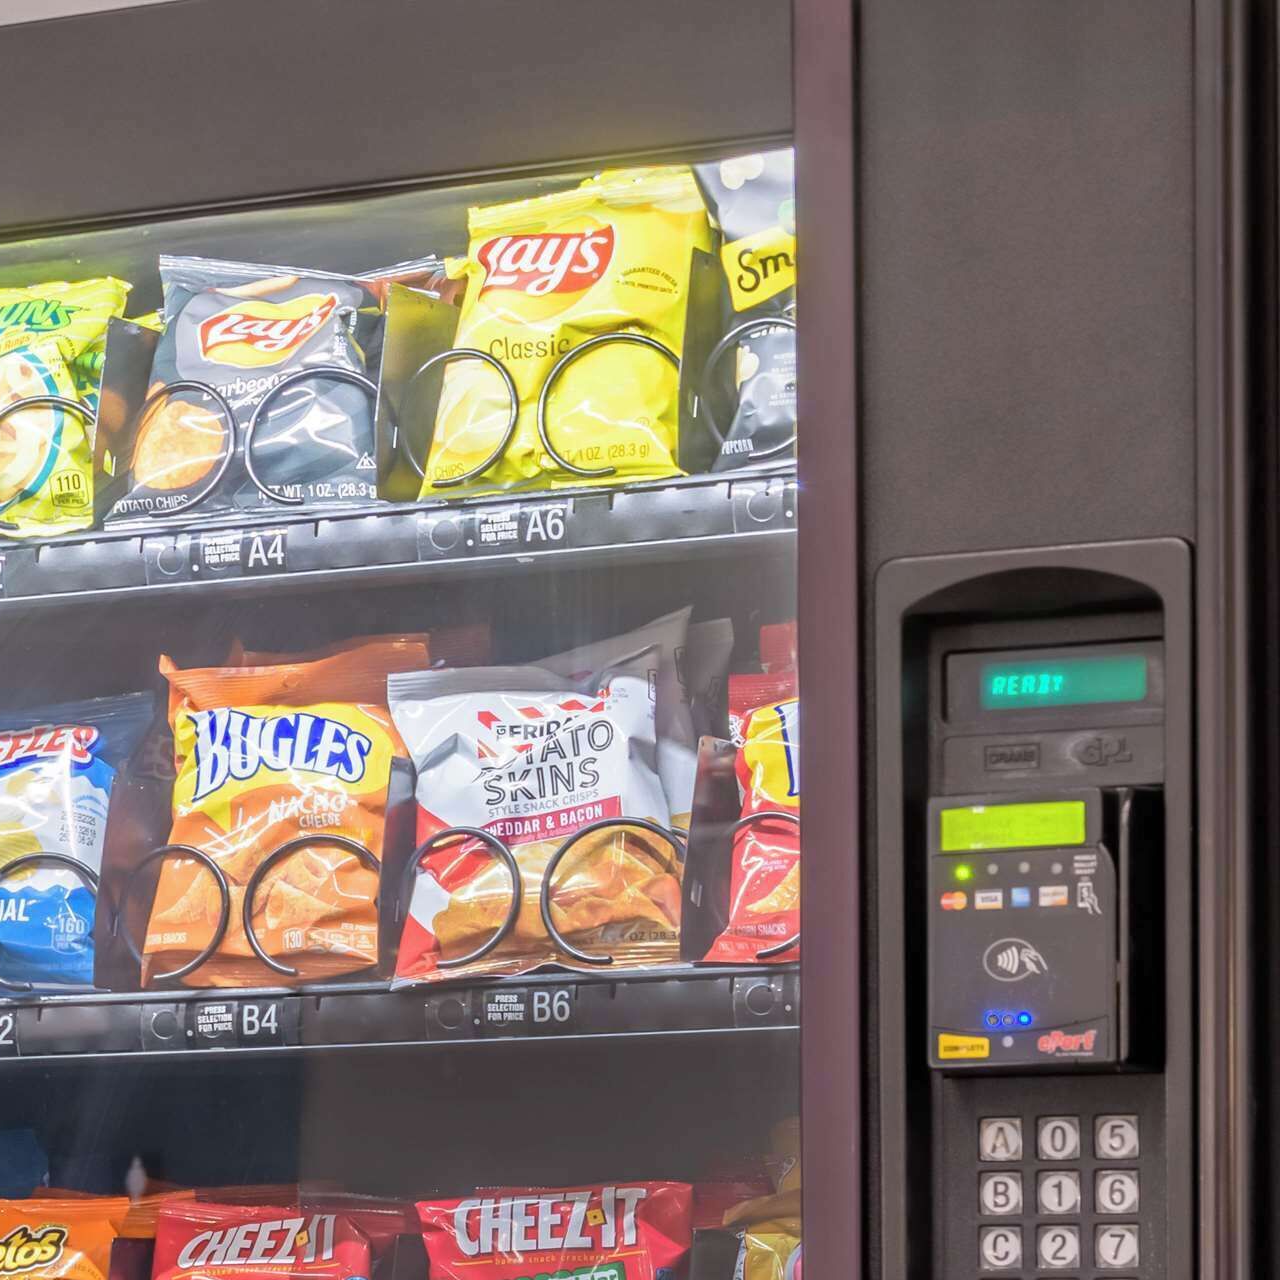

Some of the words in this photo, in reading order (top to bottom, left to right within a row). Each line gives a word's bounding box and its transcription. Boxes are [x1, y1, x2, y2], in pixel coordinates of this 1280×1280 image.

[482, 231, 609, 297] Lay's
[206, 298, 335, 351] Lay's
[489, 334, 570, 362] Classic
[56, 474, 82, 492] 110
[112, 496, 154, 514] POTATO
[156, 494, 189, 511] CHIPS
[526, 508, 565, 542] A6
[248, 534, 284, 567] A4
[188, 708, 371, 801] BUGLES
[484, 757, 600, 806] SKINS
[488, 803, 521, 818] STYLE
[524, 799, 562, 814] SNACK
[562, 788, 600, 805] CRISPS
[560, 804, 604, 825] BACON
[299, 811, 341, 828] CHEESE
[488, 1003, 525, 1012] SELECTION
[495, 994, 518, 1003] PRESS
[533, 991, 570, 1022] B6
[243, 1004, 278, 1035] B4
[488, 1012, 502, 1020] FOR
[504, 1012, 523, 1021] PRICE
[994, 1182, 1009, 1208] B
